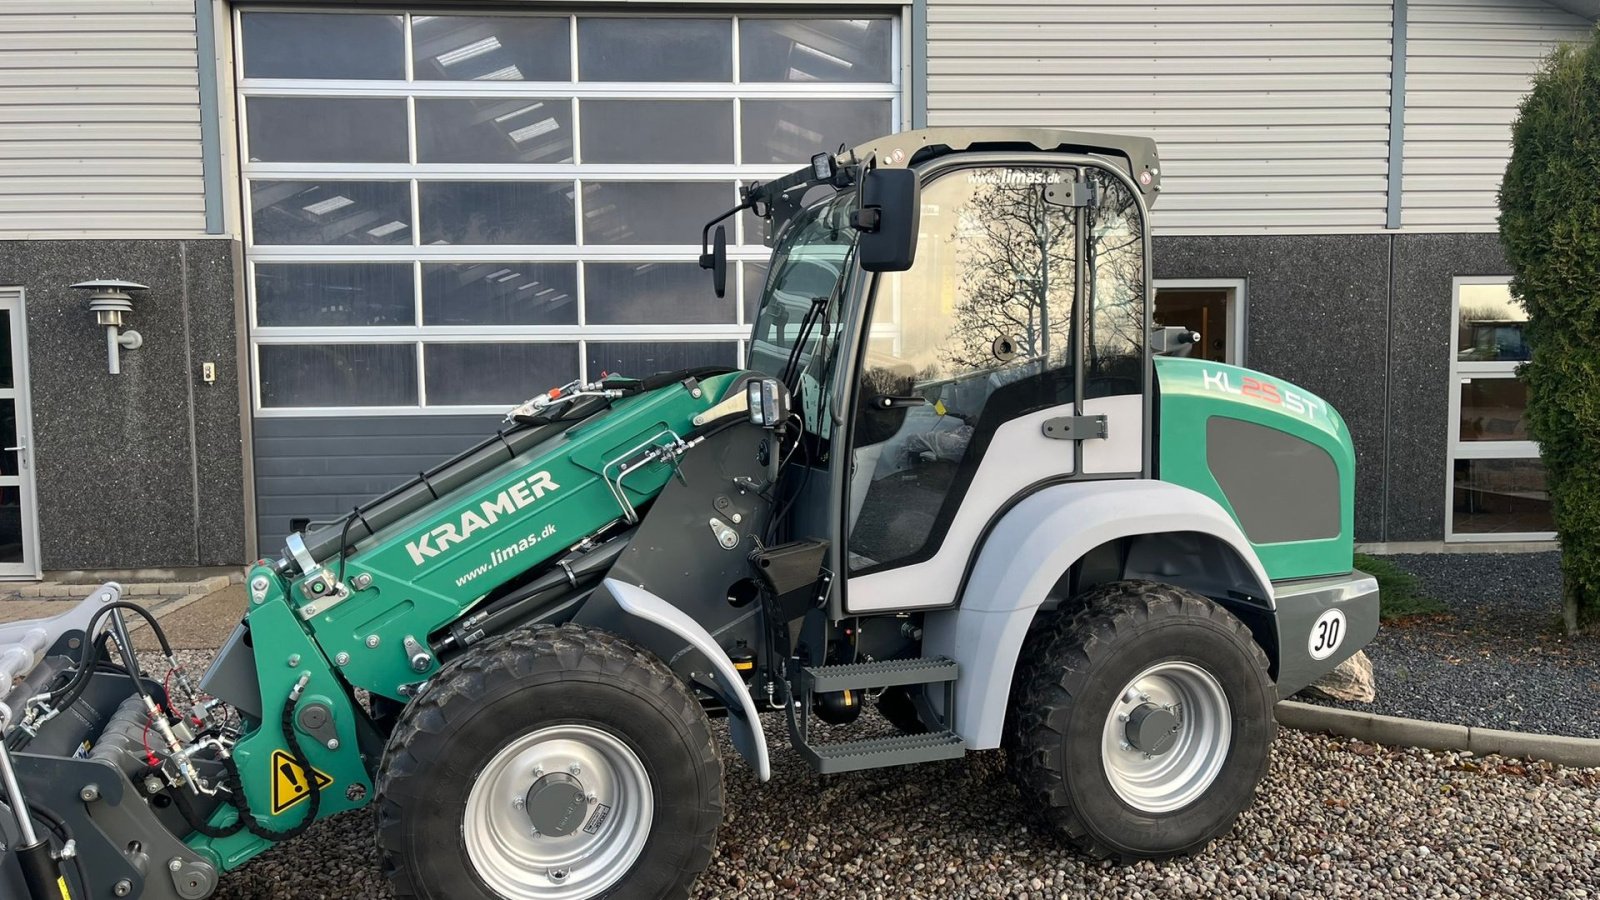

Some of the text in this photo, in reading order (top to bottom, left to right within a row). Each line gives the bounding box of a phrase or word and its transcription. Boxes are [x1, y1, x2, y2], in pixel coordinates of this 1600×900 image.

[967, 169, 1061, 184] www.limas.dk
[404, 470, 561, 566] KRAMER
[455, 523, 558, 587] www.limas.dk
[1314, 617, 1340, 651] 30
